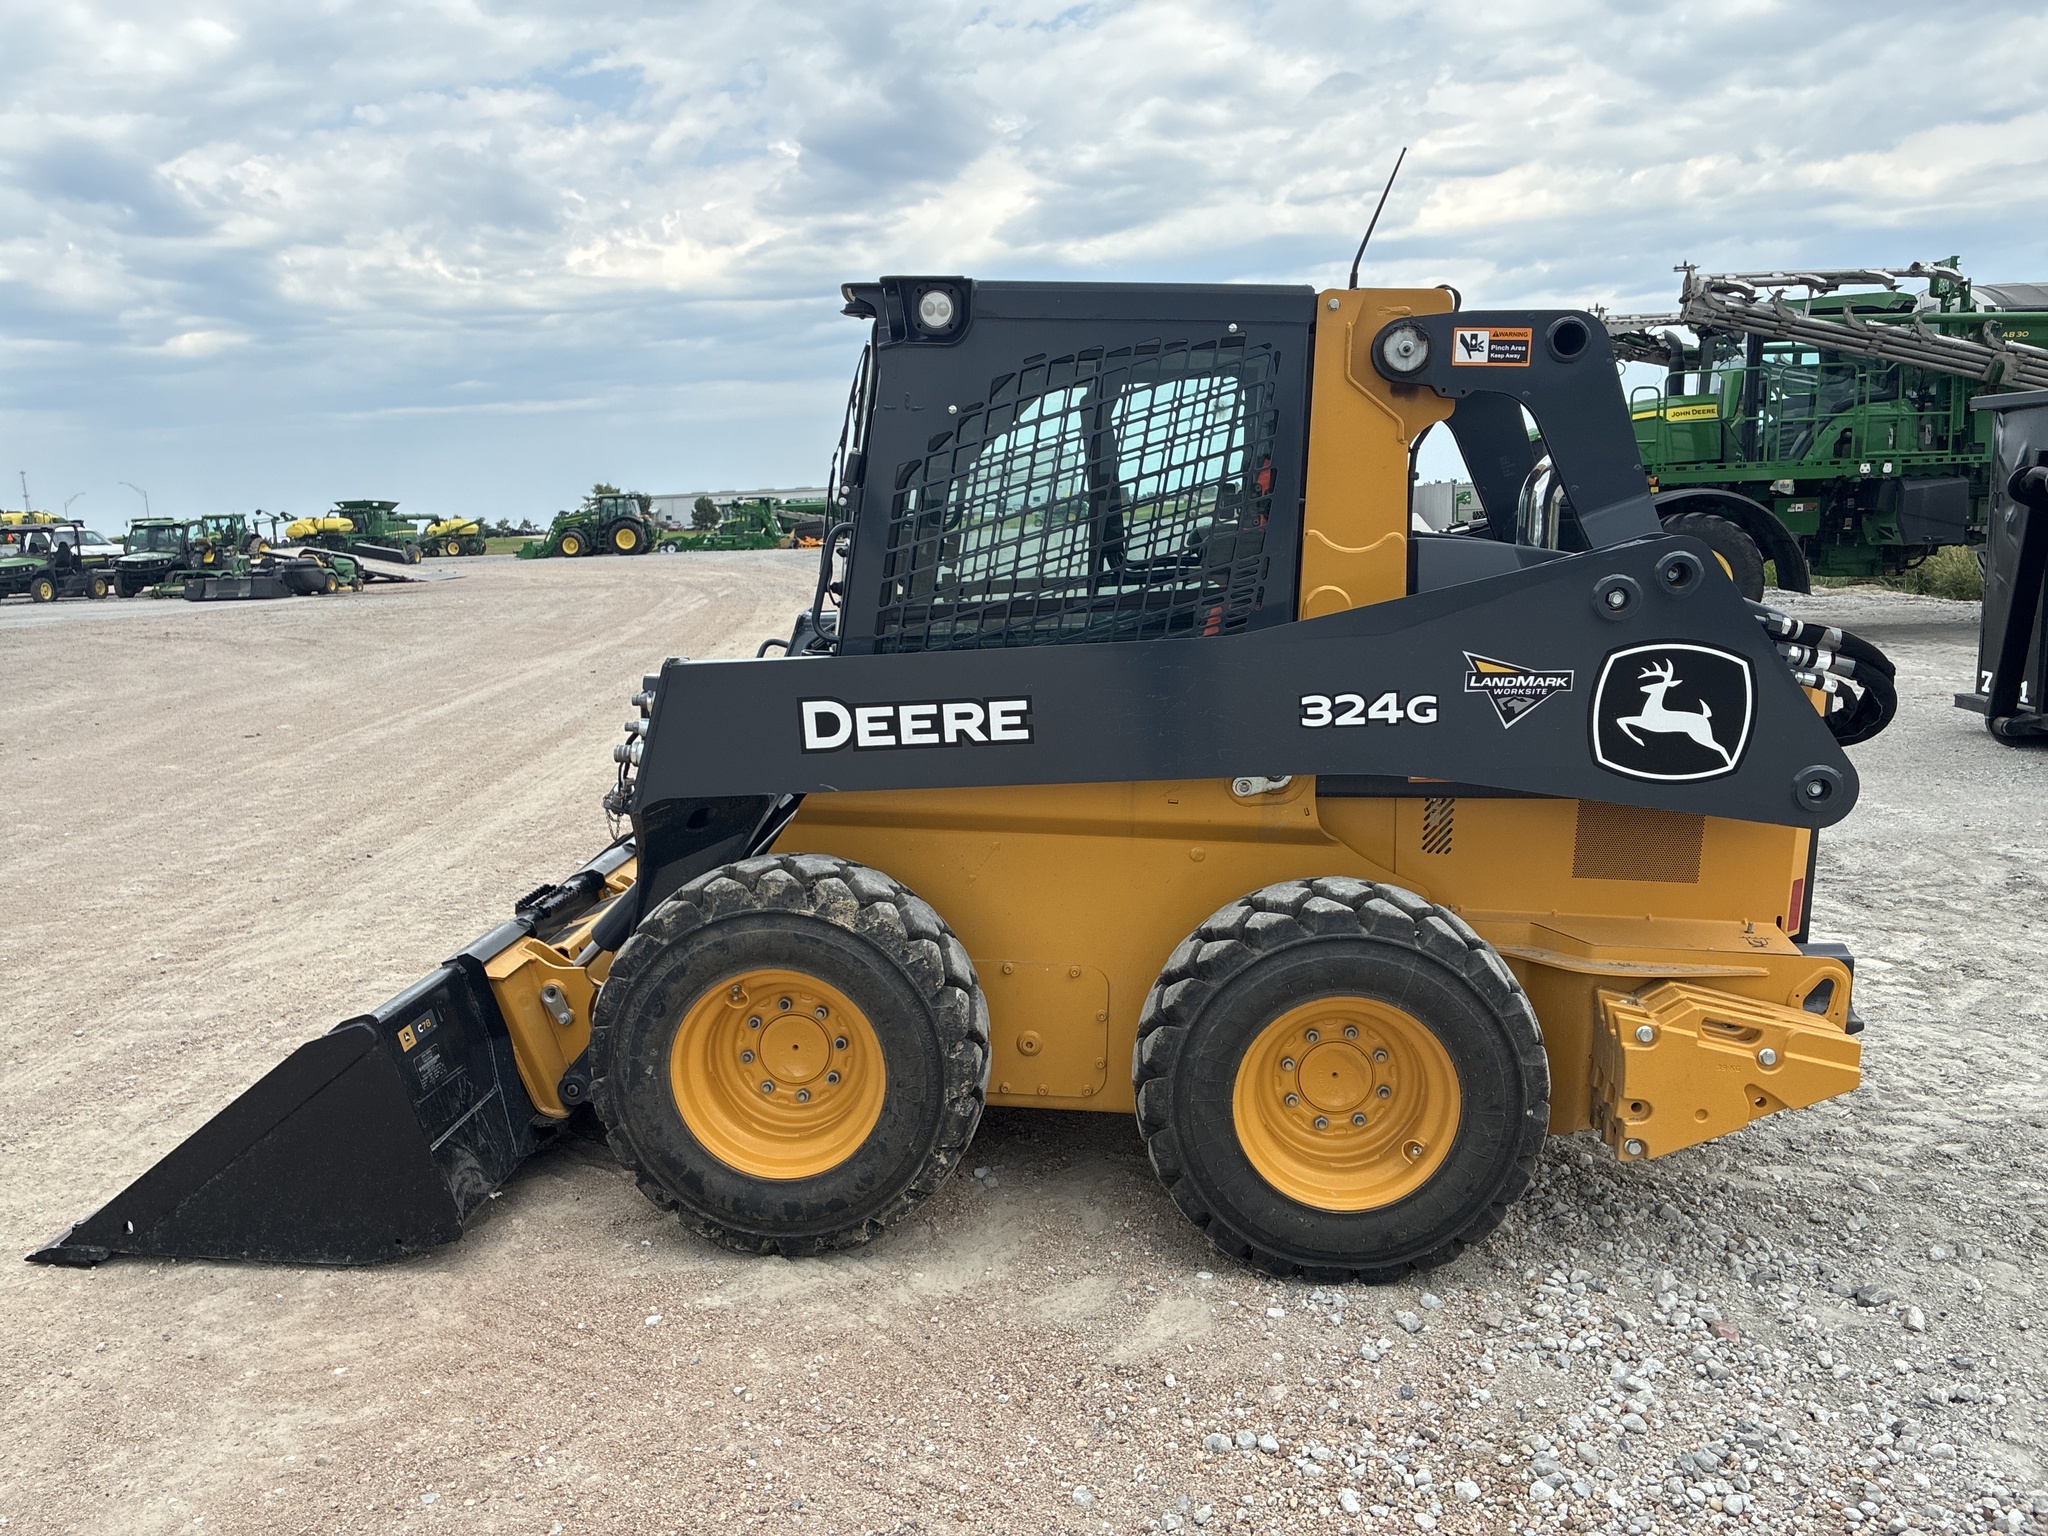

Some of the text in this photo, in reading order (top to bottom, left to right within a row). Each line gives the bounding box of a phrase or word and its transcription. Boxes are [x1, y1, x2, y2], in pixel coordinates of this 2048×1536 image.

[801, 700, 1030, 750] DEERE
[1301, 692, 1437, 727] 324G
[417, 1018, 432, 1033] C78
